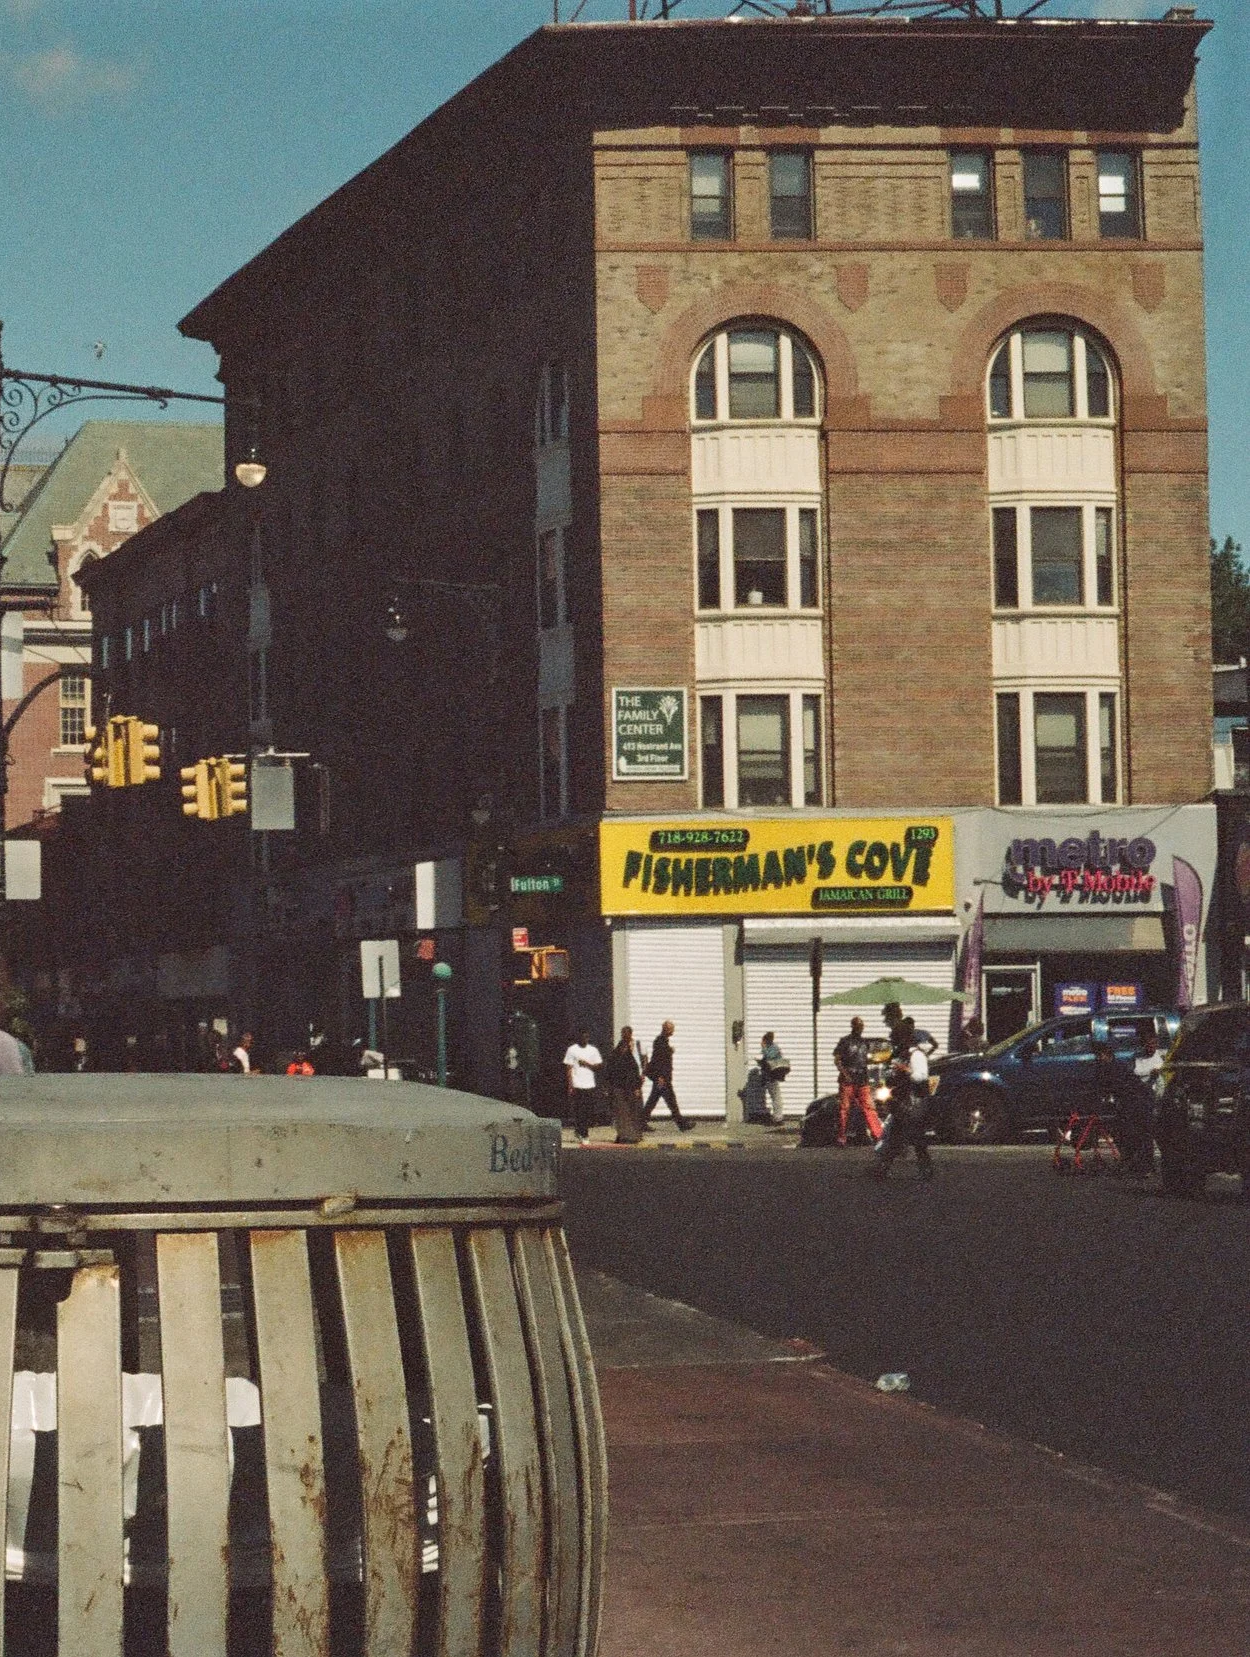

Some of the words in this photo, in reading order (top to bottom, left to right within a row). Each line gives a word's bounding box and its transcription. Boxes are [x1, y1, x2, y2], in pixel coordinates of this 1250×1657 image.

[618, 695, 641, 707] THE
[617, 709, 659, 721] FAMILY
[618, 723, 664, 735] CENTER
[649, 753, 669, 762] Floor
[658, 831, 744, 844] 718-928-7622
[910, 828, 936, 840] 1293
[1011, 830, 1157, 868] metro
[622, 841, 837, 897] FISHERMAN'S
[515, 877, 550, 892] Fulton
[1027, 870, 1055, 898] by
[818, 888, 873, 901] JAMAICAN
[876, 888, 909, 900] GRILL
[1106, 986, 1136, 996] FREE
